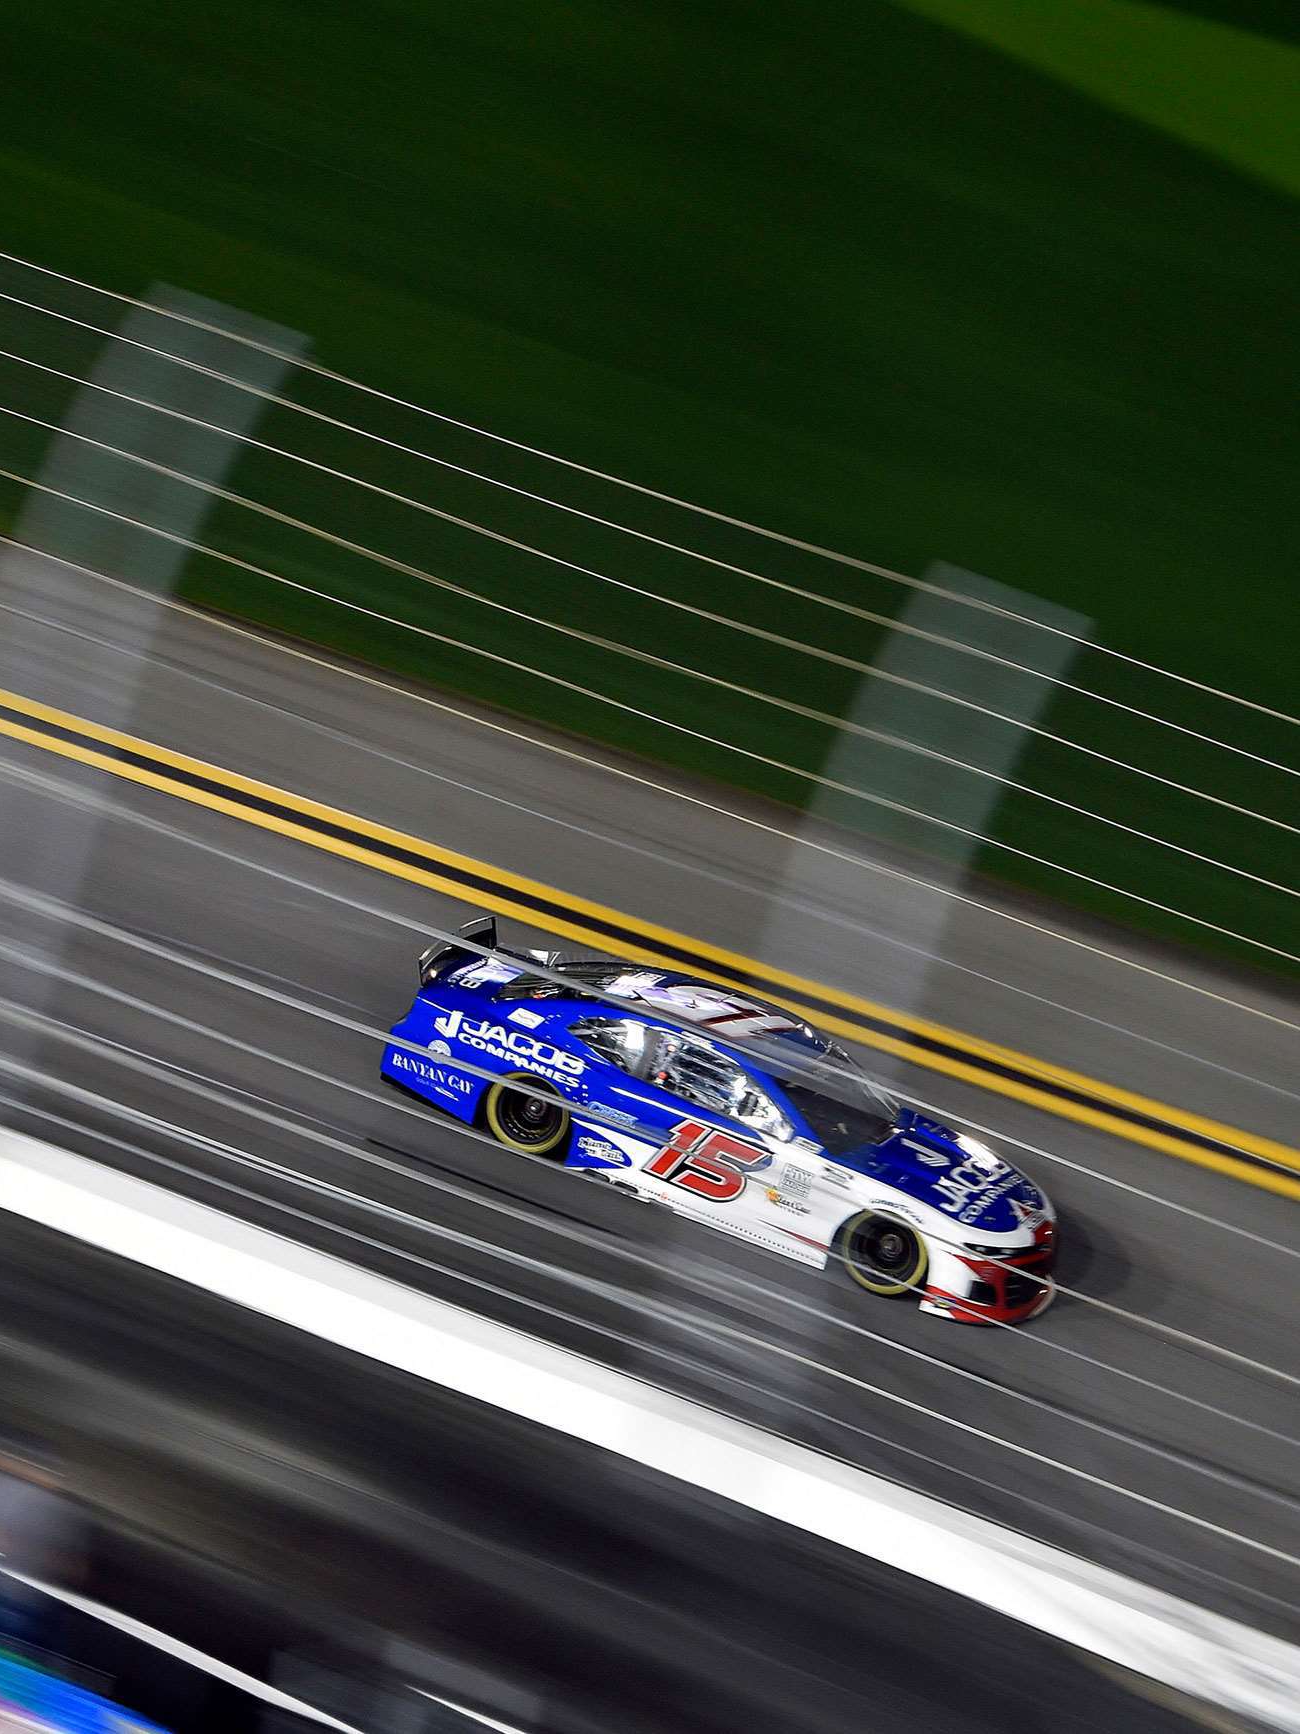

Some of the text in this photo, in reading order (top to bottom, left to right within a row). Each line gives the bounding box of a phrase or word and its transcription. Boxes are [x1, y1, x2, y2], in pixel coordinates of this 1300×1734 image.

[392, 1053, 447, 1086] BANYAN
[457, 1032, 581, 1090] COMPANIES
[462, 1020, 586, 1075] JACOB
[642, 1118, 770, 1203] 15
